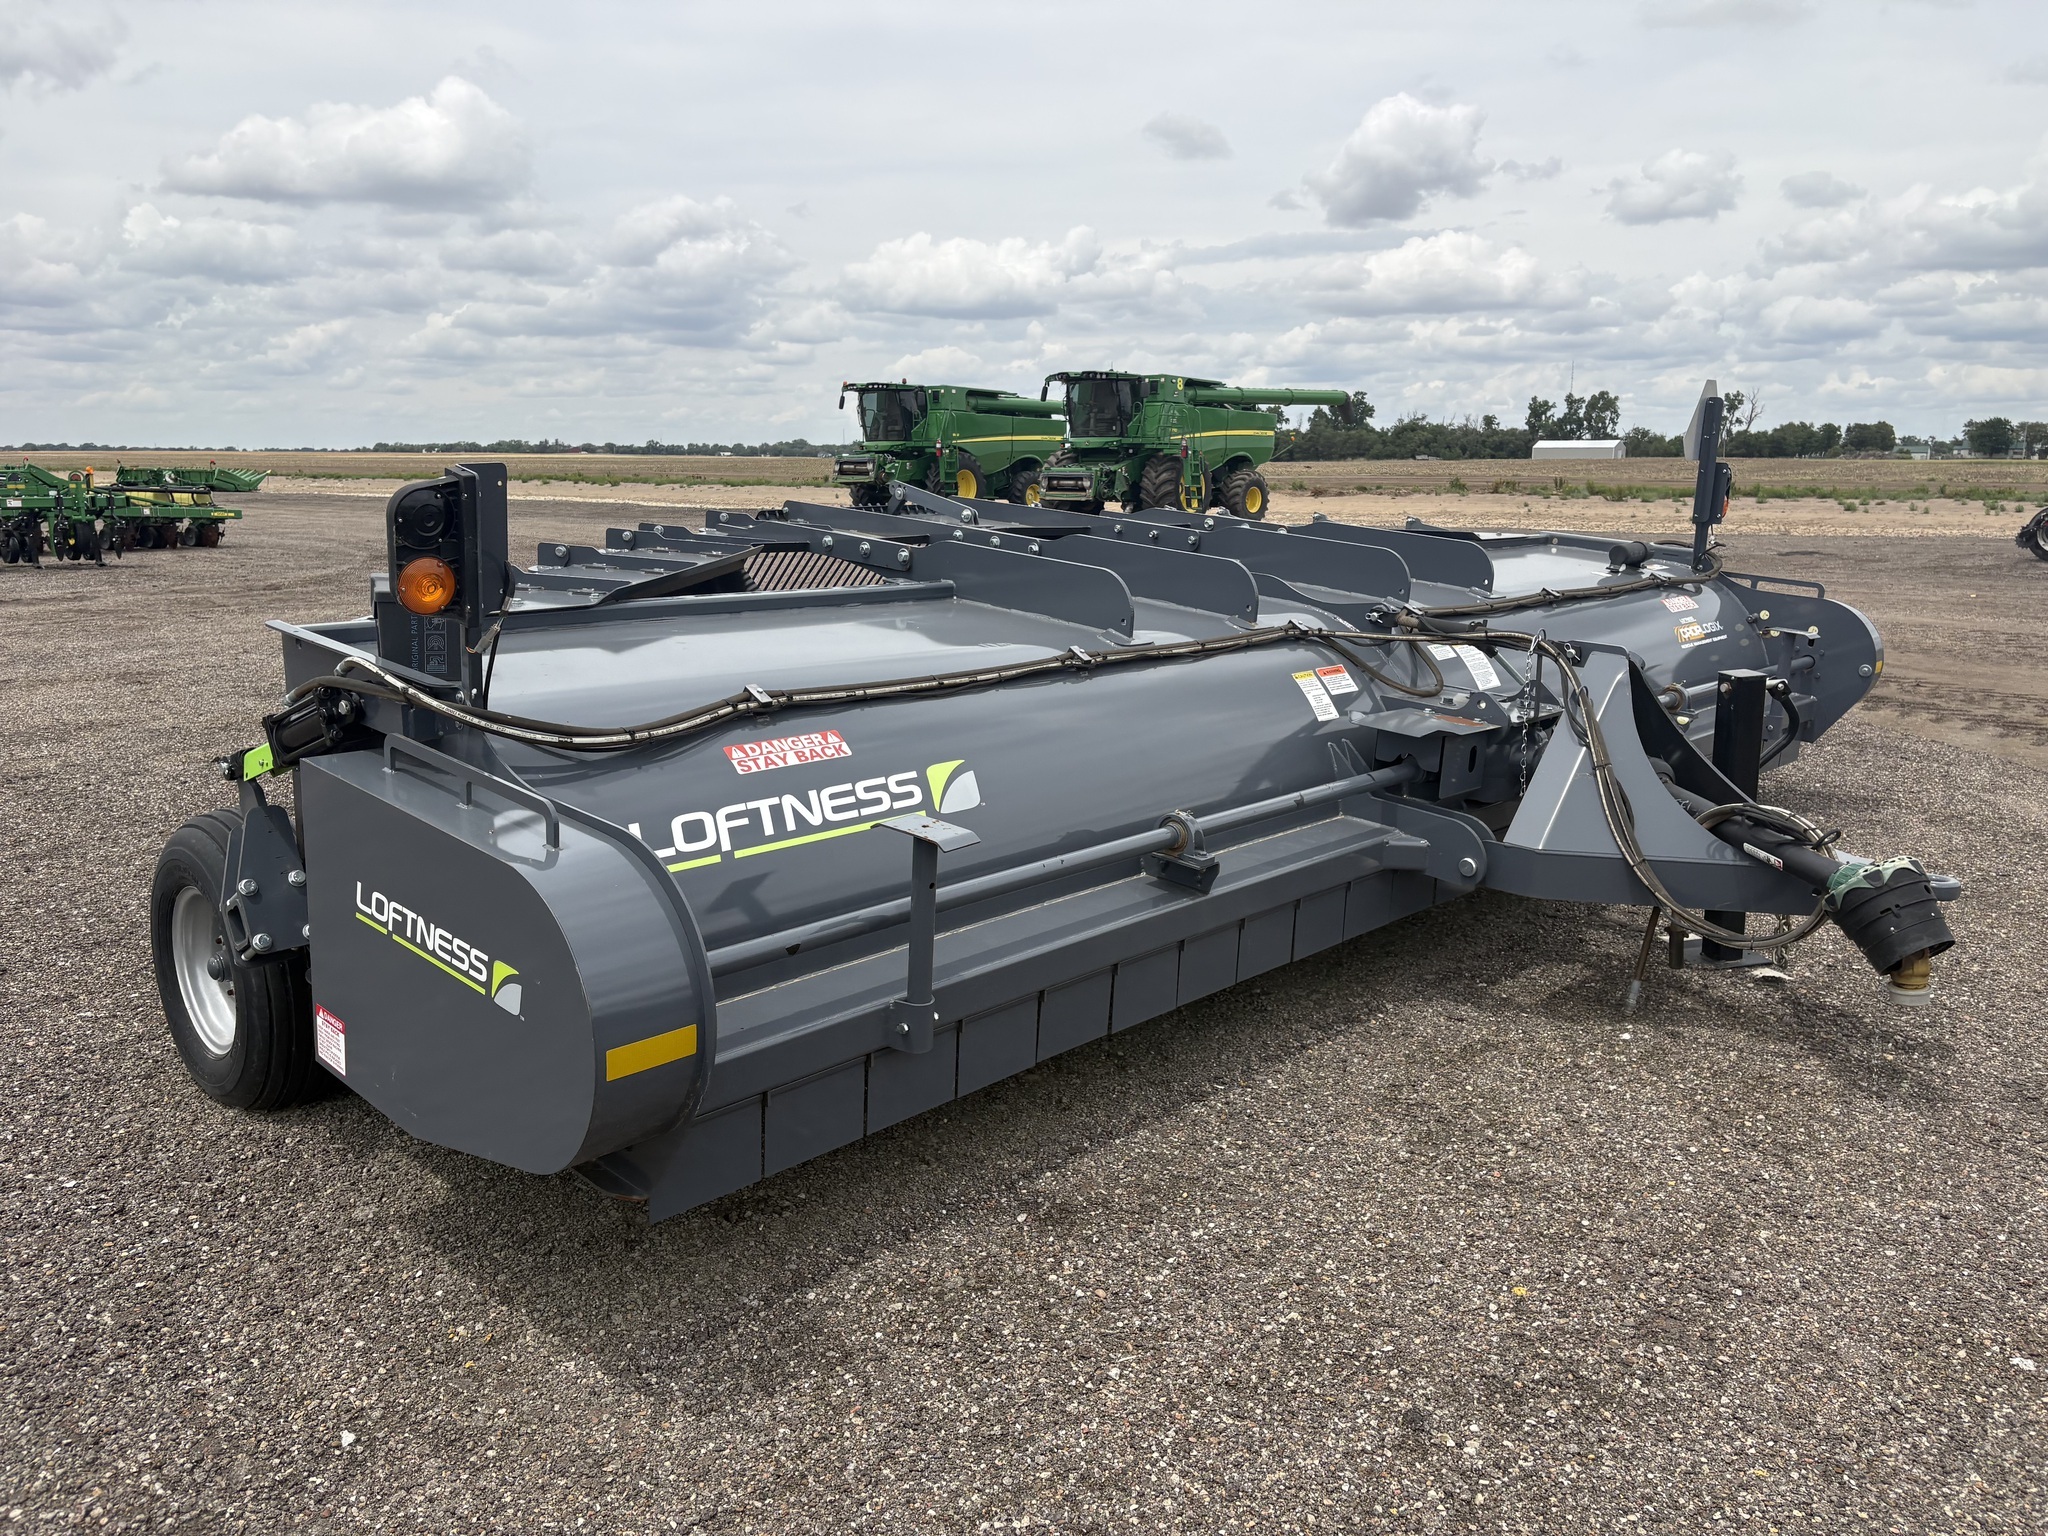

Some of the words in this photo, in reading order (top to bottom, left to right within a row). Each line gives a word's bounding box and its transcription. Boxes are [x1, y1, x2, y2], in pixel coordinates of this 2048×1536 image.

[1177, 377, 1184, 391] 8
[737, 753, 789, 772] STAY
[793, 743, 848, 763] BACK
[743, 733, 826, 757] DANGER
[628, 770, 923, 859] LOFTNESS
[356, 881, 488, 982] LOFTNESS
